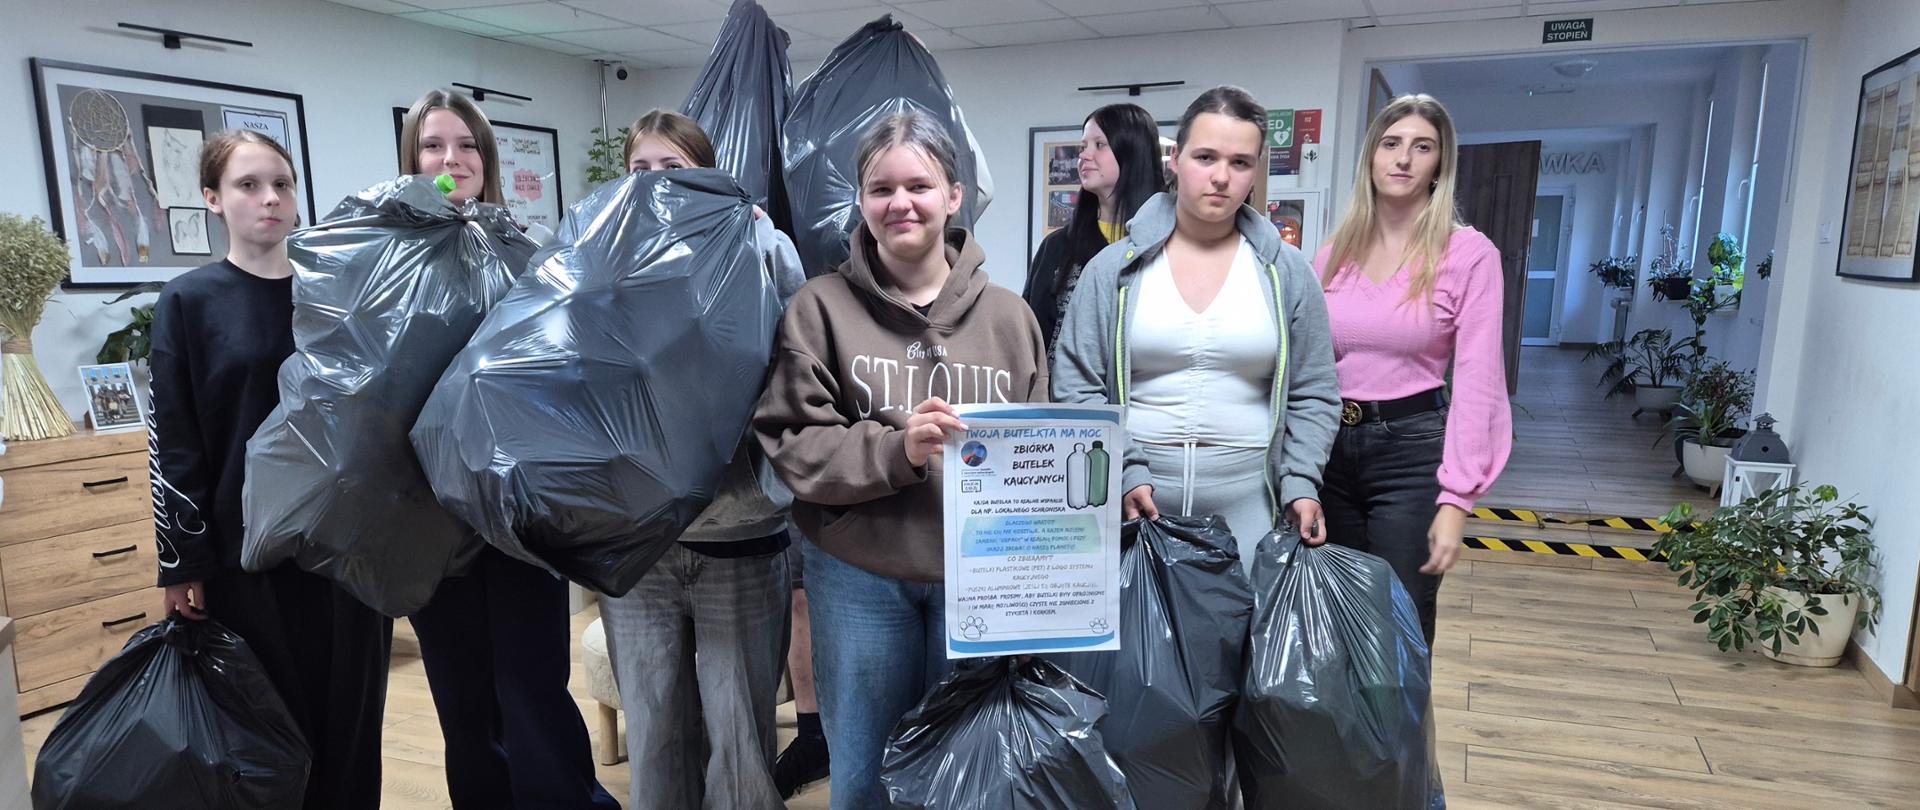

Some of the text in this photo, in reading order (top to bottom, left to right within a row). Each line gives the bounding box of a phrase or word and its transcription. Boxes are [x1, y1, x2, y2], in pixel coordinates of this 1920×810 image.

[1551, 21, 1586, 31] UWAGA
[244, 121, 268, 130] NASZA
[1268, 120, 1284, 130] ED
[906, 341, 926, 360] City
[966, 428, 1102, 439] TWOJA BUTELKTA MA MOC
[1012, 459, 1055, 470] BUTELEK
[1004, 474, 1064, 486] KAUCYJNYCH
